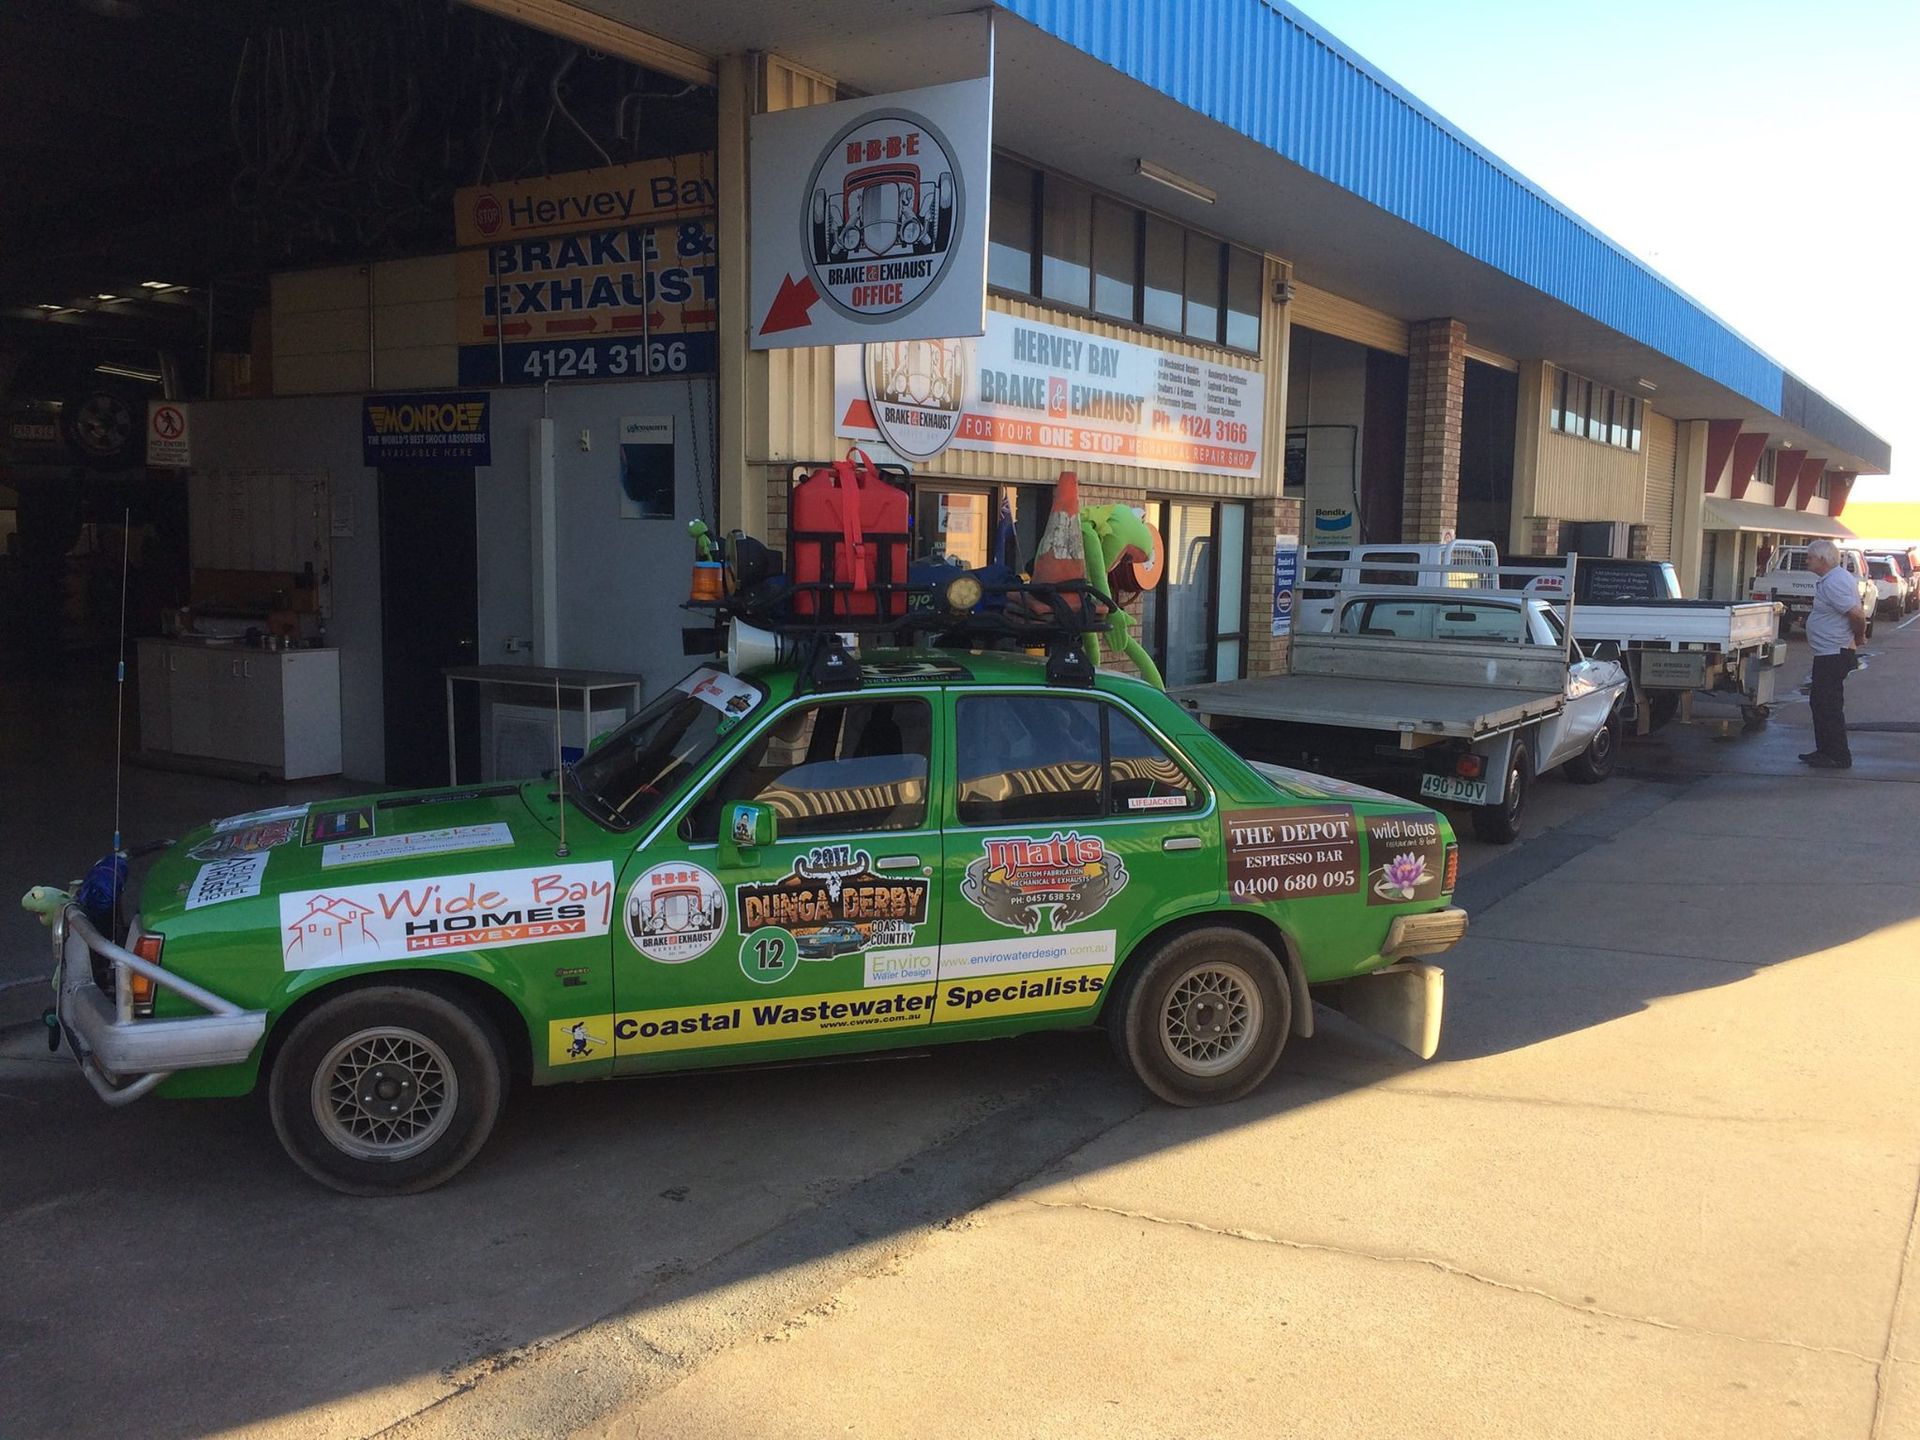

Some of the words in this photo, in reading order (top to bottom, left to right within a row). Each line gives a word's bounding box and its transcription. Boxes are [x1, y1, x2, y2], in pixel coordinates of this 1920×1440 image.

[477, 206, 499, 226] STOP
[508, 188, 635, 227] Hervey
[487, 226, 658, 275] BRAKE
[677, 223, 716, 257] &
[828, 266, 865, 286] BRAKE
[866, 265, 879, 282] &
[880, 259, 933, 281] EXHAUST
[484, 266, 717, 317] EXHAUST
[852, 283, 903, 307] OFFICE
[523, 347, 597, 376] 4124
[608, 342, 687, 373] 3166
[1014, 327, 1083, 372] HERVEY
[1088, 344, 1120, 379] BAY
[981, 368, 1045, 411] BRAKE
[1050, 379, 1066, 415] &
[1071, 384, 1144, 425] EXHAUST
[384, 404, 469, 432] MONROE
[885, 407, 909, 425] BRAKE
[919, 412, 951, 430] EXHAUST
[1179, 414, 1211, 439] 4124
[1216, 419, 1248, 444] 3166
[367, 435, 379, 445] THE
[382, 435, 409, 445] WORLD'S
[410, 434, 424, 444] BEST
[425, 434, 447, 444] SHOCK
[448, 432, 486, 443] ABSORBERS
[965, 418, 992, 437] FOR
[999, 422, 1032, 443] YOUR
[1039, 426, 1073, 448] ONE
[1079, 430, 1123, 453] STOP
[1128, 438, 1189, 459] MECHANICAL
[1193, 447, 1226, 464] REPAIR
[1228, 451, 1250, 466] SHOP
[381, 448, 437, 457] AVAILABLE
[444, 447, 473, 456] HERE
[1315, 508, 1346, 516] Bendix
[1131, 797, 1183, 807] LIFEJACKETS
[1231, 826, 1276, 846] THE
[1281, 820, 1350, 841] DEPOT
[1372, 821, 1400, 839] wild
[1402, 820, 1436, 837] lotus
[811, 846, 850, 867] 2017
[986, 833, 1103, 878] Matts
[1246, 852, 1312, 869] ESPRESSO
[1316, 850, 1343, 863] BAR
[1011, 878, 1050, 887] MECHANICAL
[1057, 875, 1090, 884] EXHAUSTS
[1016, 870, 1042, 878] CUSTOM
[1044, 868, 1083, 877] FABRICATION
[1234, 877, 1279, 897] 0400
[1284, 874, 1317, 891] 680
[1323, 870, 1355, 888] 095
[198, 889, 248, 903] HOTEL
[378, 883, 508, 919] Wide
[531, 874, 611, 926] Bay
[745, 889, 833, 928] DUNGA
[843, 886, 924, 918] DERBY
[1011, 896, 1024, 905] PH:
[1026, 895, 1047, 903] 0457
[1049, 893, 1064, 901] 638
[1066, 892, 1081, 901] 529
[406, 904, 585, 935] HOMES
[872, 920, 903, 932] COAST
[409, 926, 521, 949] HERVEY
[528, 920, 582, 936] BAY
[643, 937, 668, 947] BRAKE
[678, 932, 712, 944] EXHAUST
[871, 932, 914, 945] COUNTRY
[755, 939, 784, 970] 12
[872, 953, 931, 974] Enviro
[941, 944, 1108, 968] www.envirowaterdesign.com.au
[872, 970, 899, 981] Water
[901, 967, 931, 979] Design
[615, 1009, 740, 1040] Coastal
[753, 993, 937, 1026] Wastewater
[946, 975, 1104, 1009] Specialists
[820, 1014, 921, 1031] www.cwws.com.au
